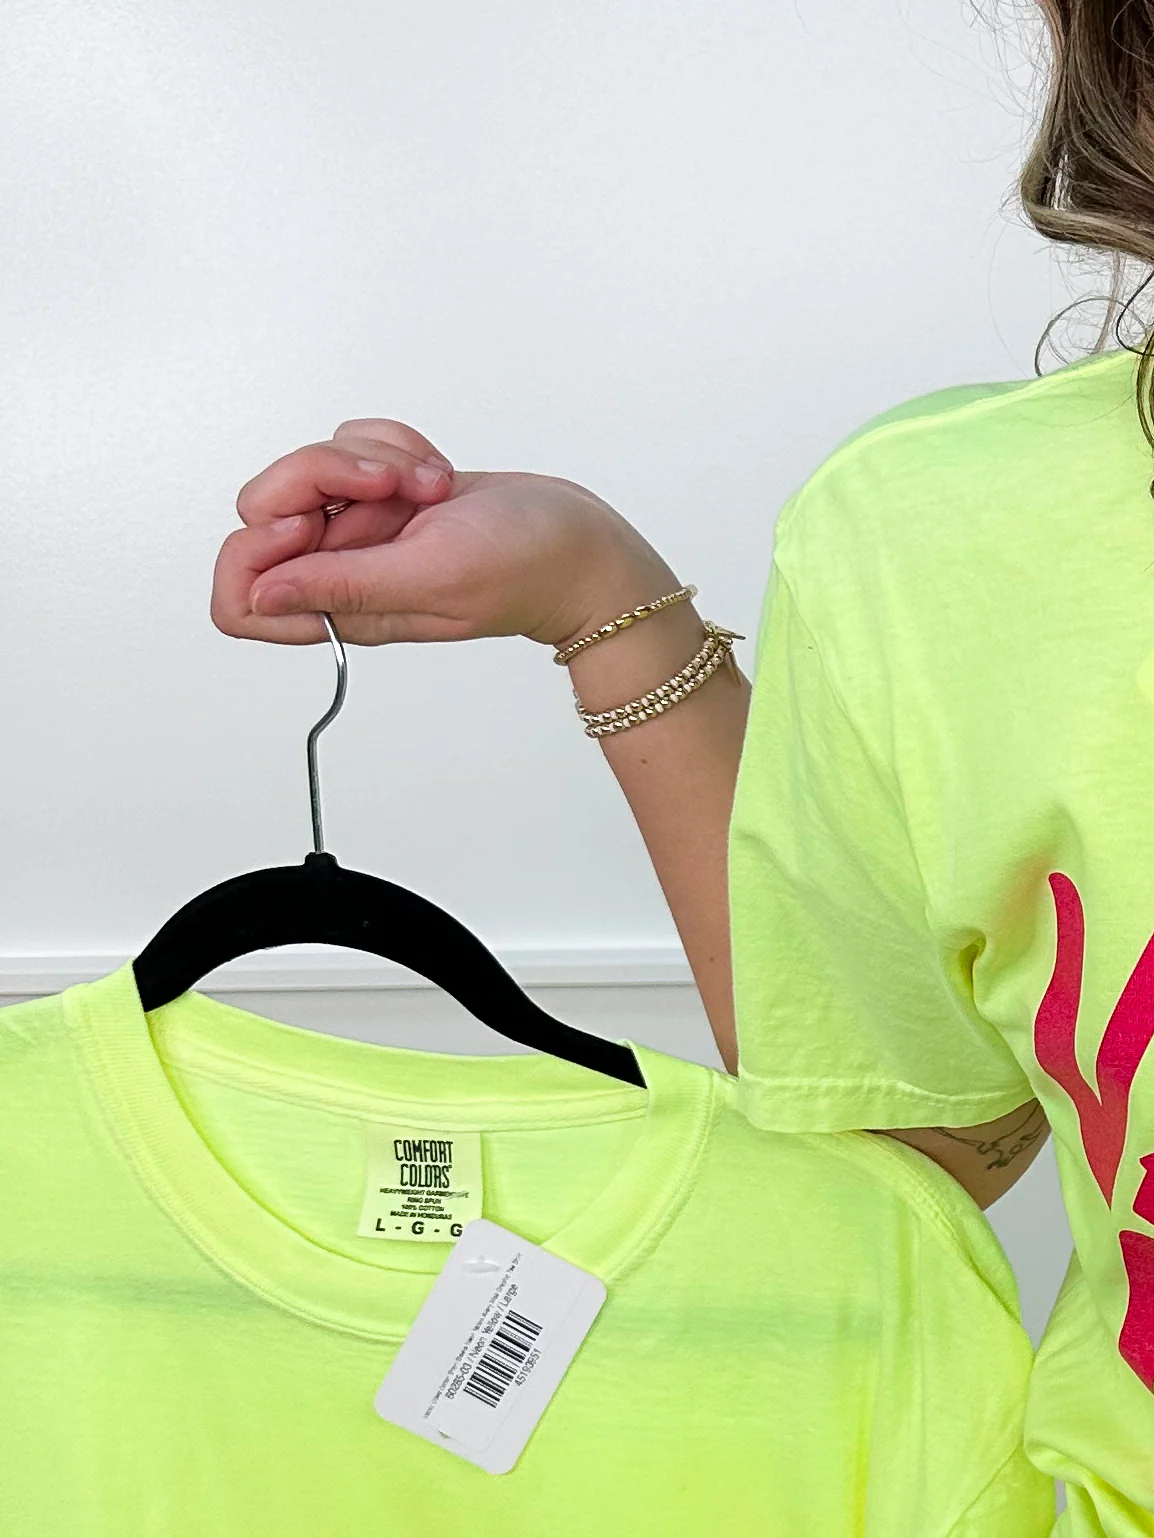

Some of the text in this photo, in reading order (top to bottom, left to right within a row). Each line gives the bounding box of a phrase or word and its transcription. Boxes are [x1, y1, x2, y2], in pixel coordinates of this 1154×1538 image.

[393, 1139, 453, 1163] COMFORT
[472, 1337, 488, 1359] Neon
[480, 1310, 503, 1335] Yellow
[503, 1283, 519, 1308] Large
